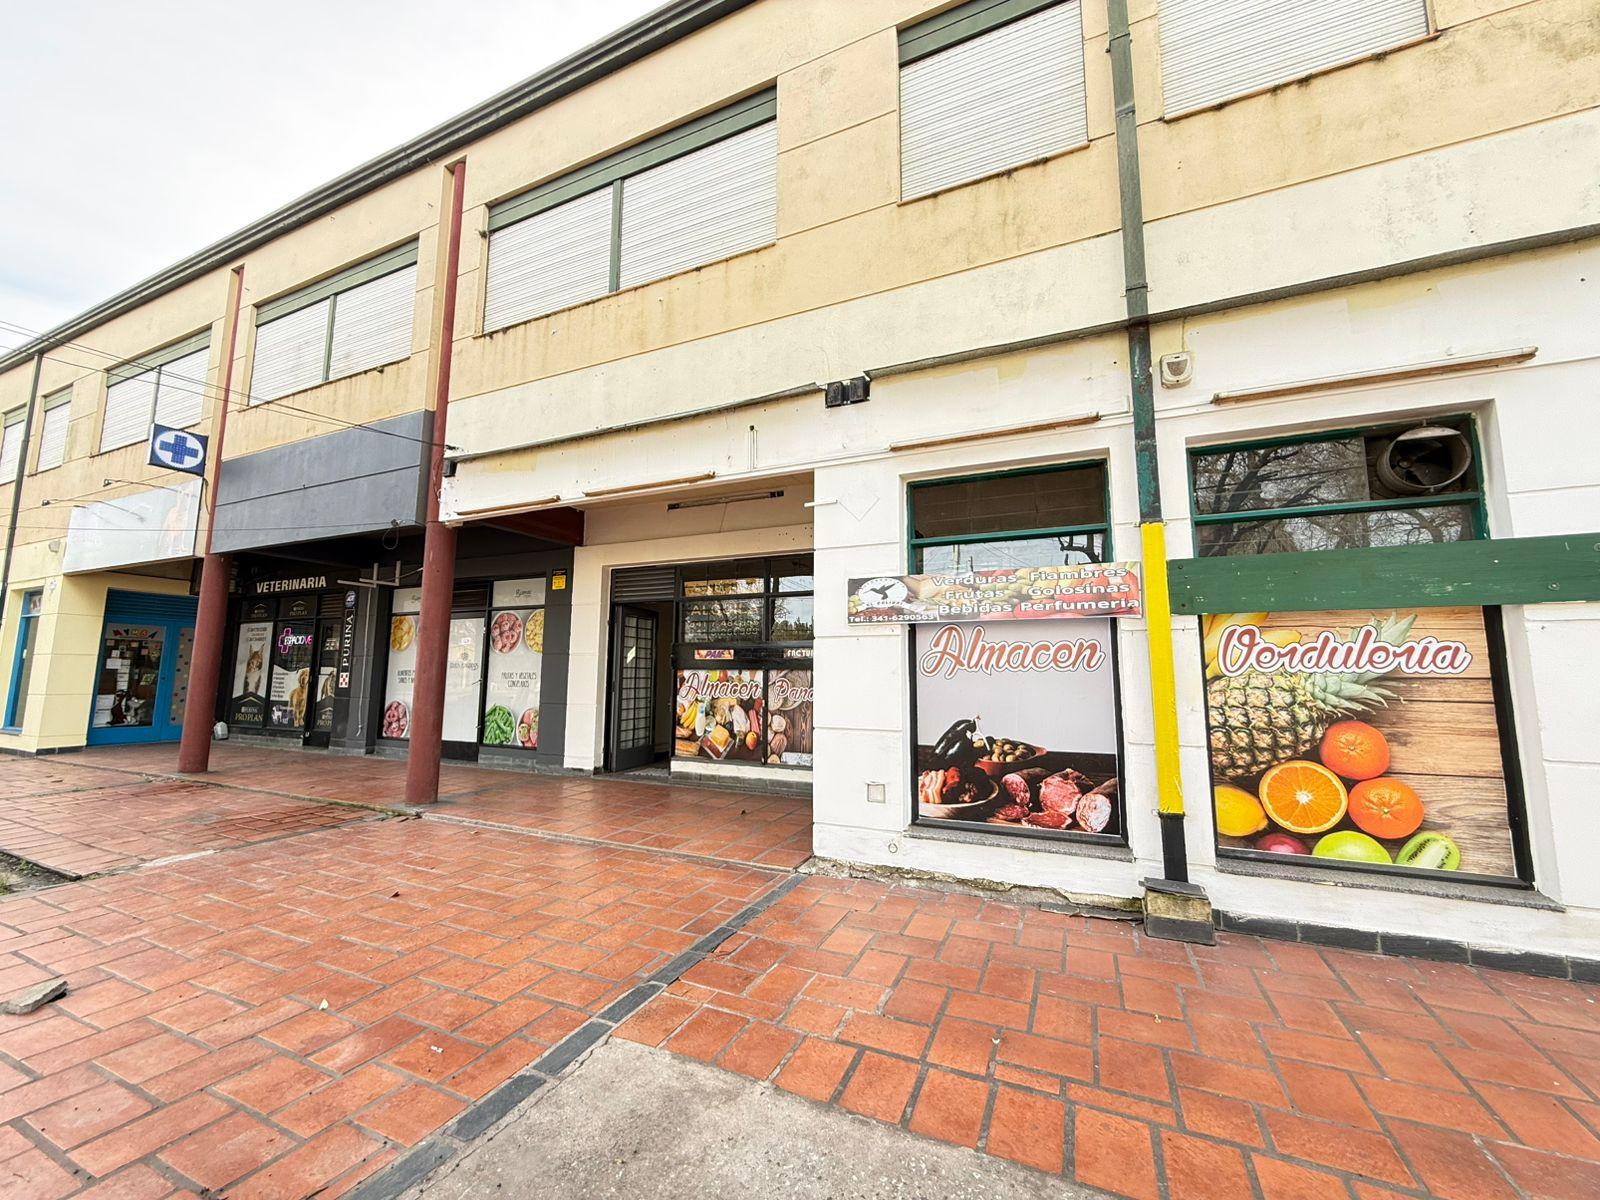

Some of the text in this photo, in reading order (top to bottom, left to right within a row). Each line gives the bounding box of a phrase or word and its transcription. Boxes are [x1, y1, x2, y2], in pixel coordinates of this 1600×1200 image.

[256, 576, 327, 593] VETERINARIA
[932, 567, 1128, 586] Verduras Fiambres
[945, 583, 1130, 600] Frutas Golosinas
[939, 602, 1013, 615] Bebidas
[848, 613, 935, 623] Tel.: 341-6290563
[342, 614, 354, 667] PURINA
[920, 625, 1106, 679] Almacen
[678, 671, 761, 700] Almacen
